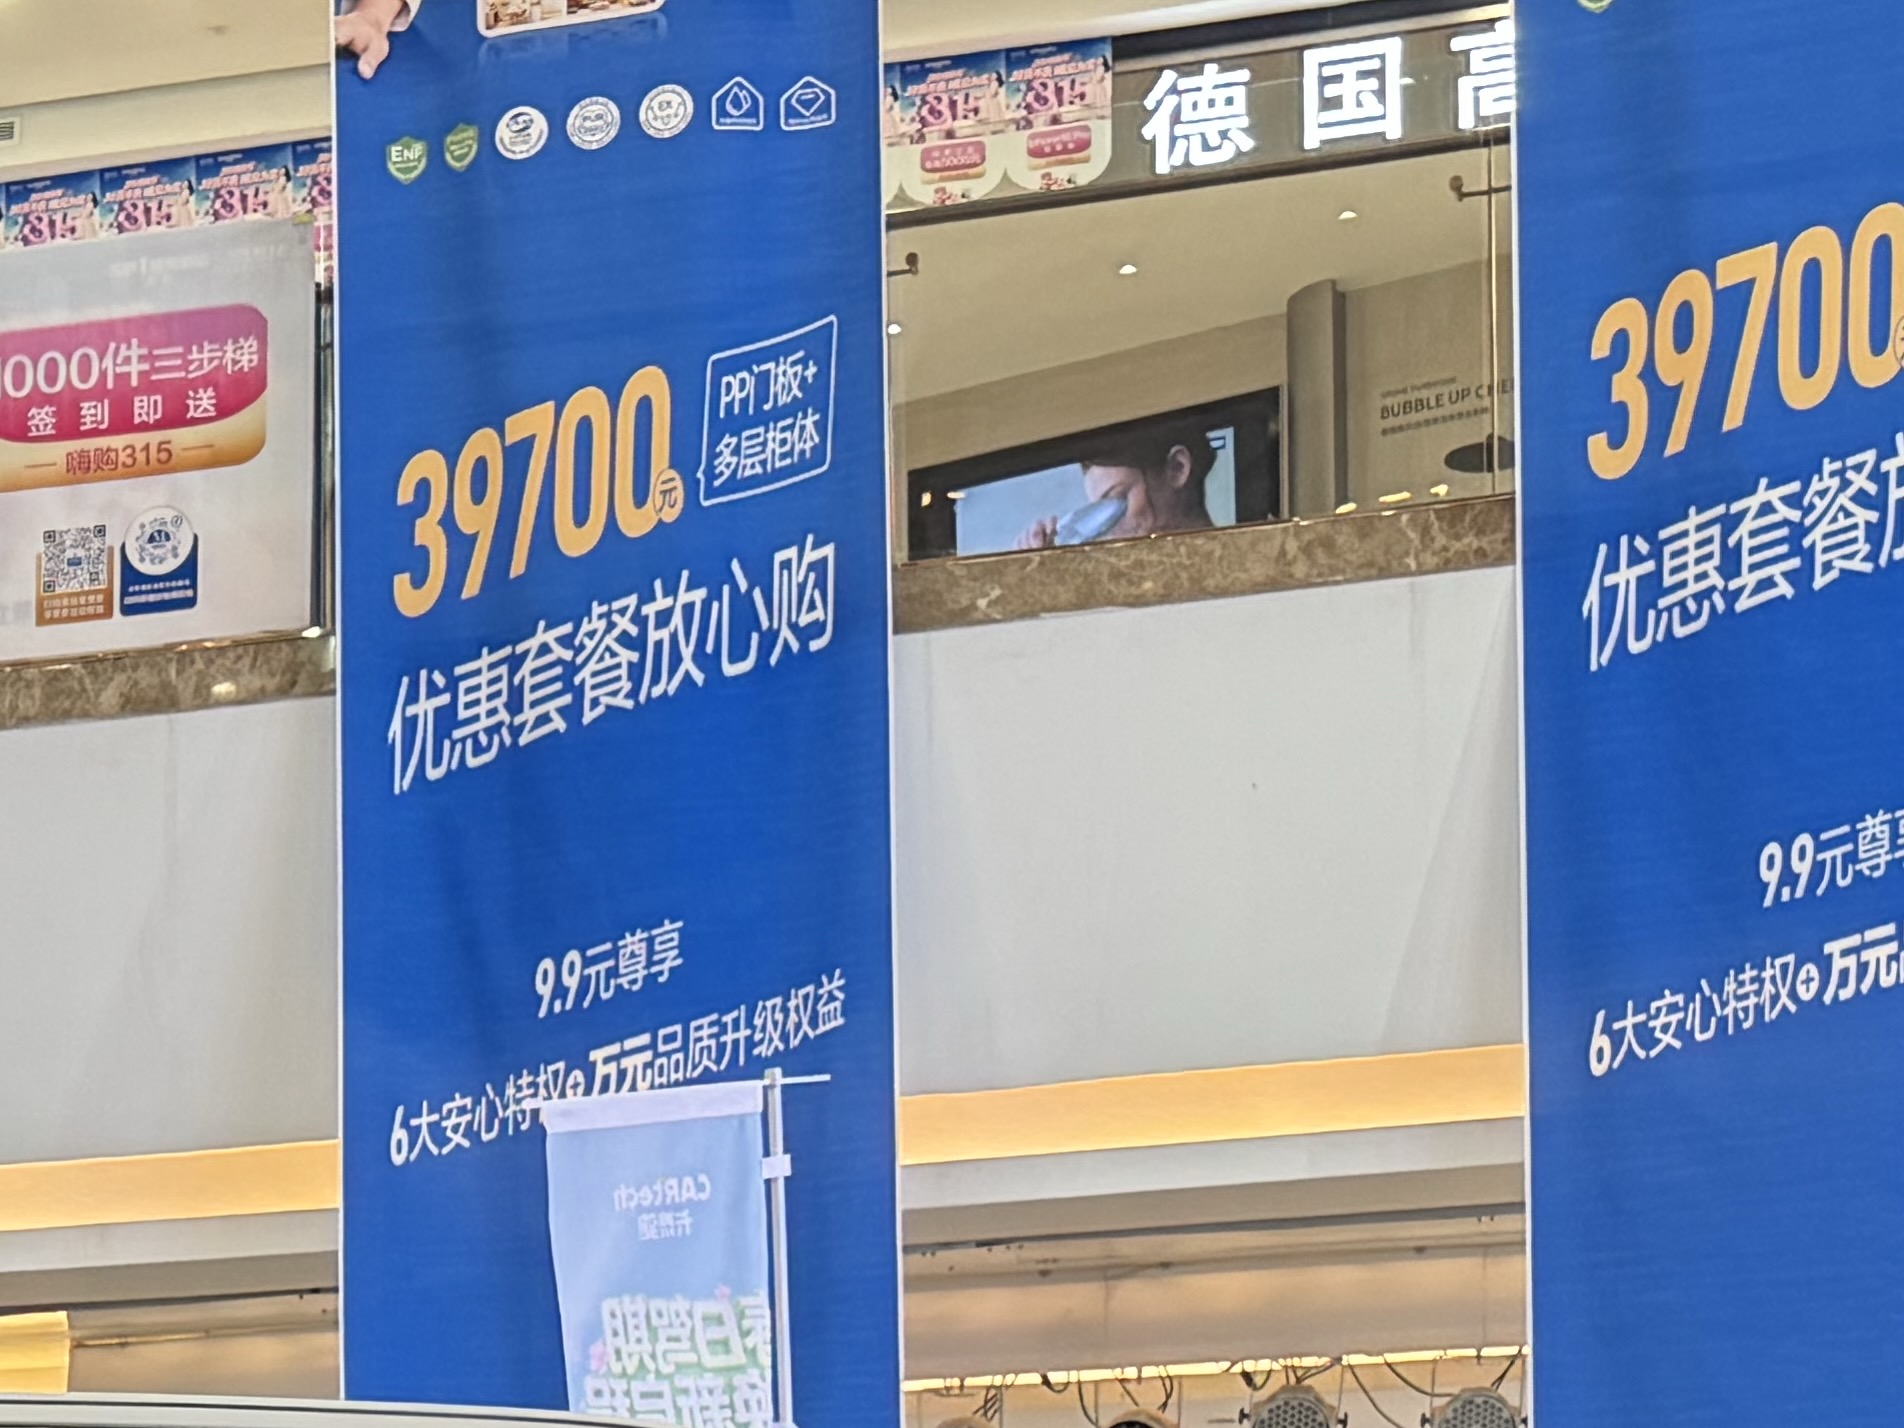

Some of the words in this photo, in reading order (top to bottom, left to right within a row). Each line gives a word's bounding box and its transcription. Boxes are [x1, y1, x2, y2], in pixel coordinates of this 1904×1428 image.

[1587, 202, 1904, 480] 39700
[27, 386, 216, 437] 签到即送
[65, 440, 172, 475] 嗨购315
[714, 407, 820, 487] 多层柜体
[388, 533, 835, 795] 优惠套餐放心购
[1759, 808, 1904, 908] 9.9元尊
[535, 919, 685, 1019] 9.9元尊享
[1589, 922, 1904, 1077] 6大安心特权+万元
